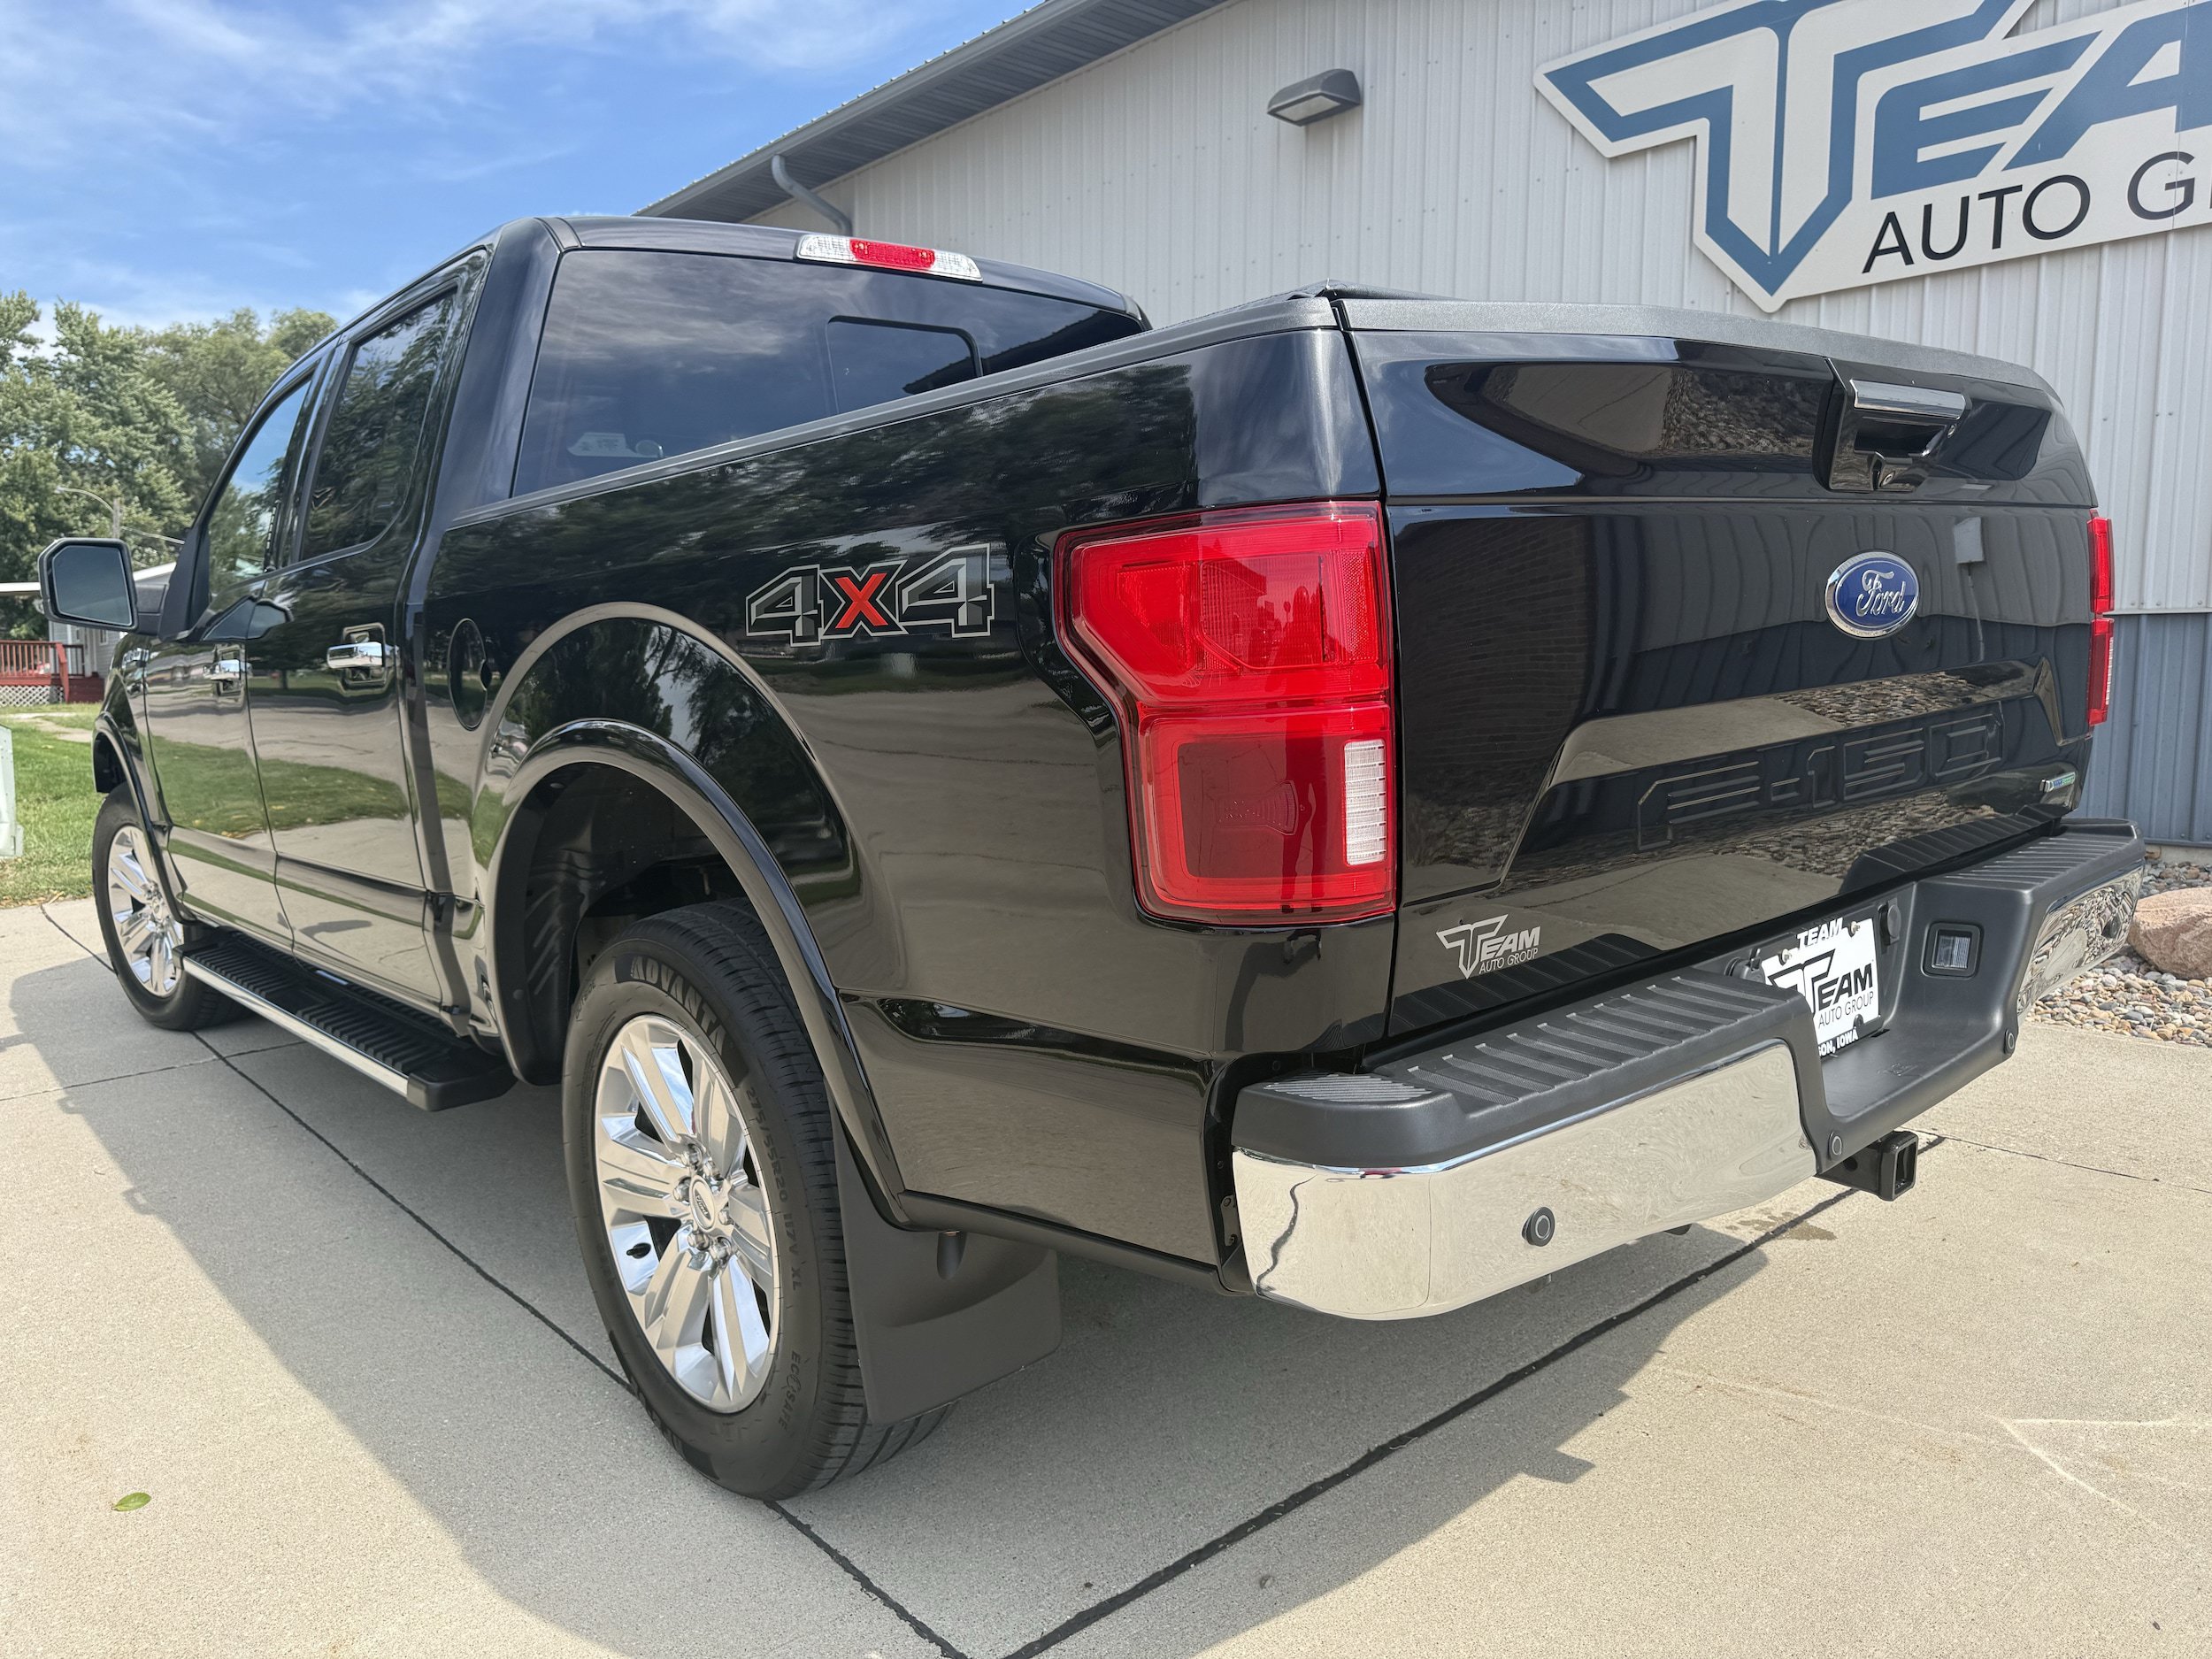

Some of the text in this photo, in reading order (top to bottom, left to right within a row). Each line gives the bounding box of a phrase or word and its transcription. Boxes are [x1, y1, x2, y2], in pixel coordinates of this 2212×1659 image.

[1862, 150, 2212, 274] AUTO G
[1855, 569, 1906, 617] Ford
[1638, 707, 2006, 851] F-150
[1436, 914, 1541, 979] TEAM
[1797, 917, 1844, 949] TEAM
[1479, 948, 1539, 975] AUTO GROUP
[629, 955, 727, 1057] ADVANTA
[1818, 991, 1875, 1030] AUTO GROUP
[1836, 1028, 1859, 1049] IOWA
